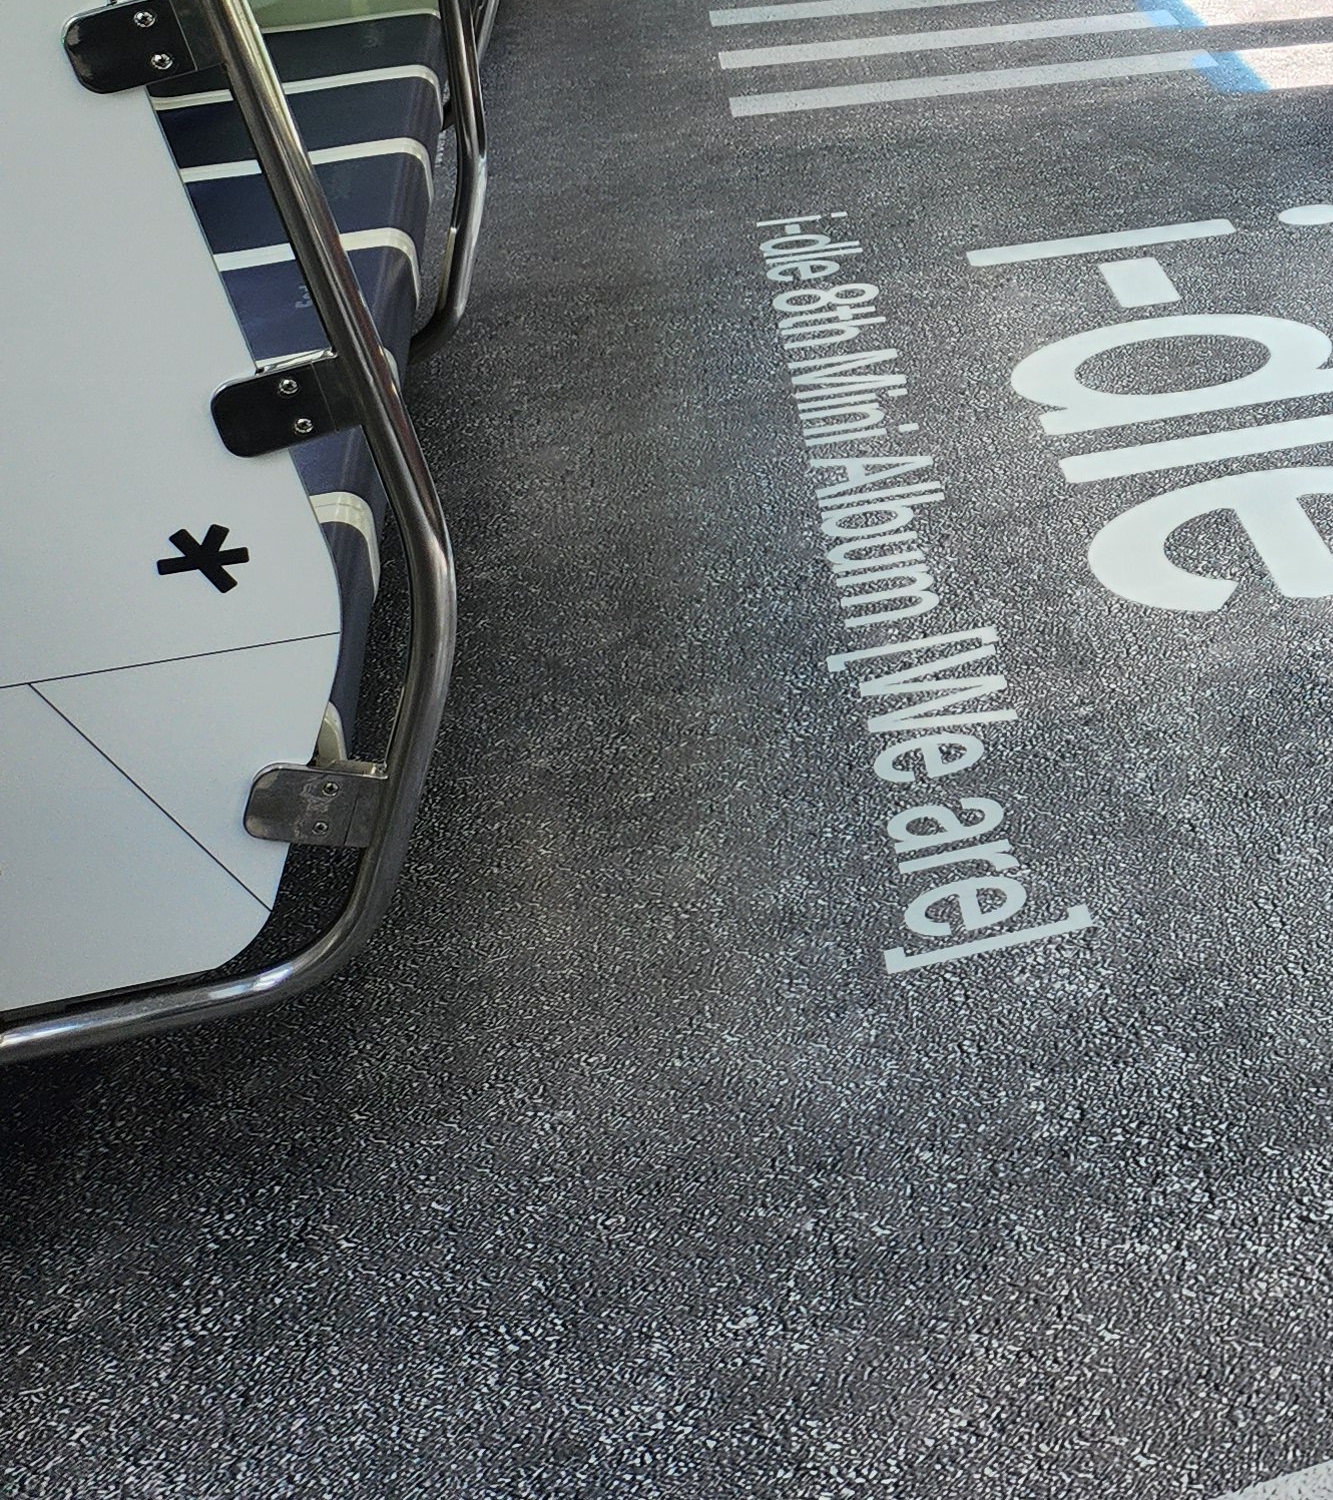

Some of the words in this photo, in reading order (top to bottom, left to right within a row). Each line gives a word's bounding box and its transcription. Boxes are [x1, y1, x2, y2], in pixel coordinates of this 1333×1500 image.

[756, 211, 864, 282] i-dle
[771, 282, 887, 349] 8th
[787, 347, 920, 448] Mini
[810, 455, 946, 631] Album
[827, 625, 1019, 786] [We
[883, 793, 1099, 975] are]
